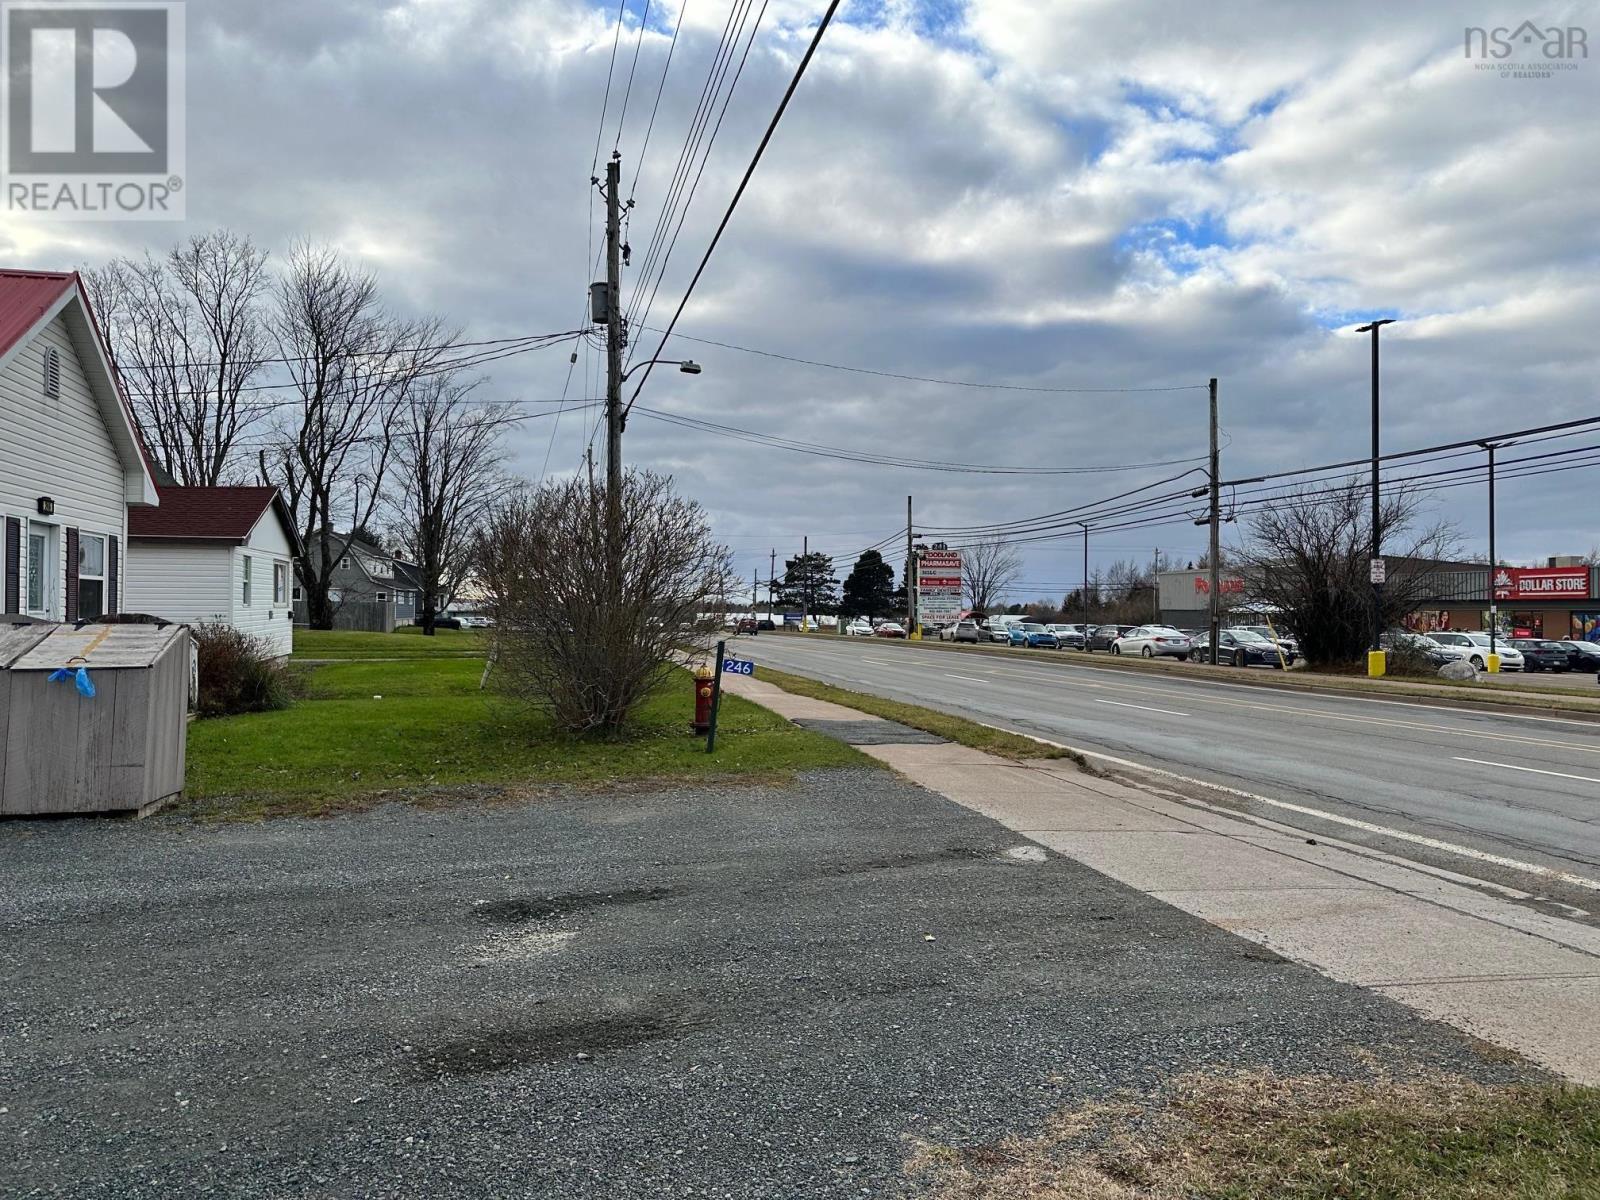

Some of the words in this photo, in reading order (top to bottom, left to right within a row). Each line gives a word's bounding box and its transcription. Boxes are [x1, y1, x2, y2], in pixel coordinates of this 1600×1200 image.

[1519, 579, 1554, 591] DOLLAR
[1555, 578, 1587, 590] STORE
[726, 660, 751, 674] 246
